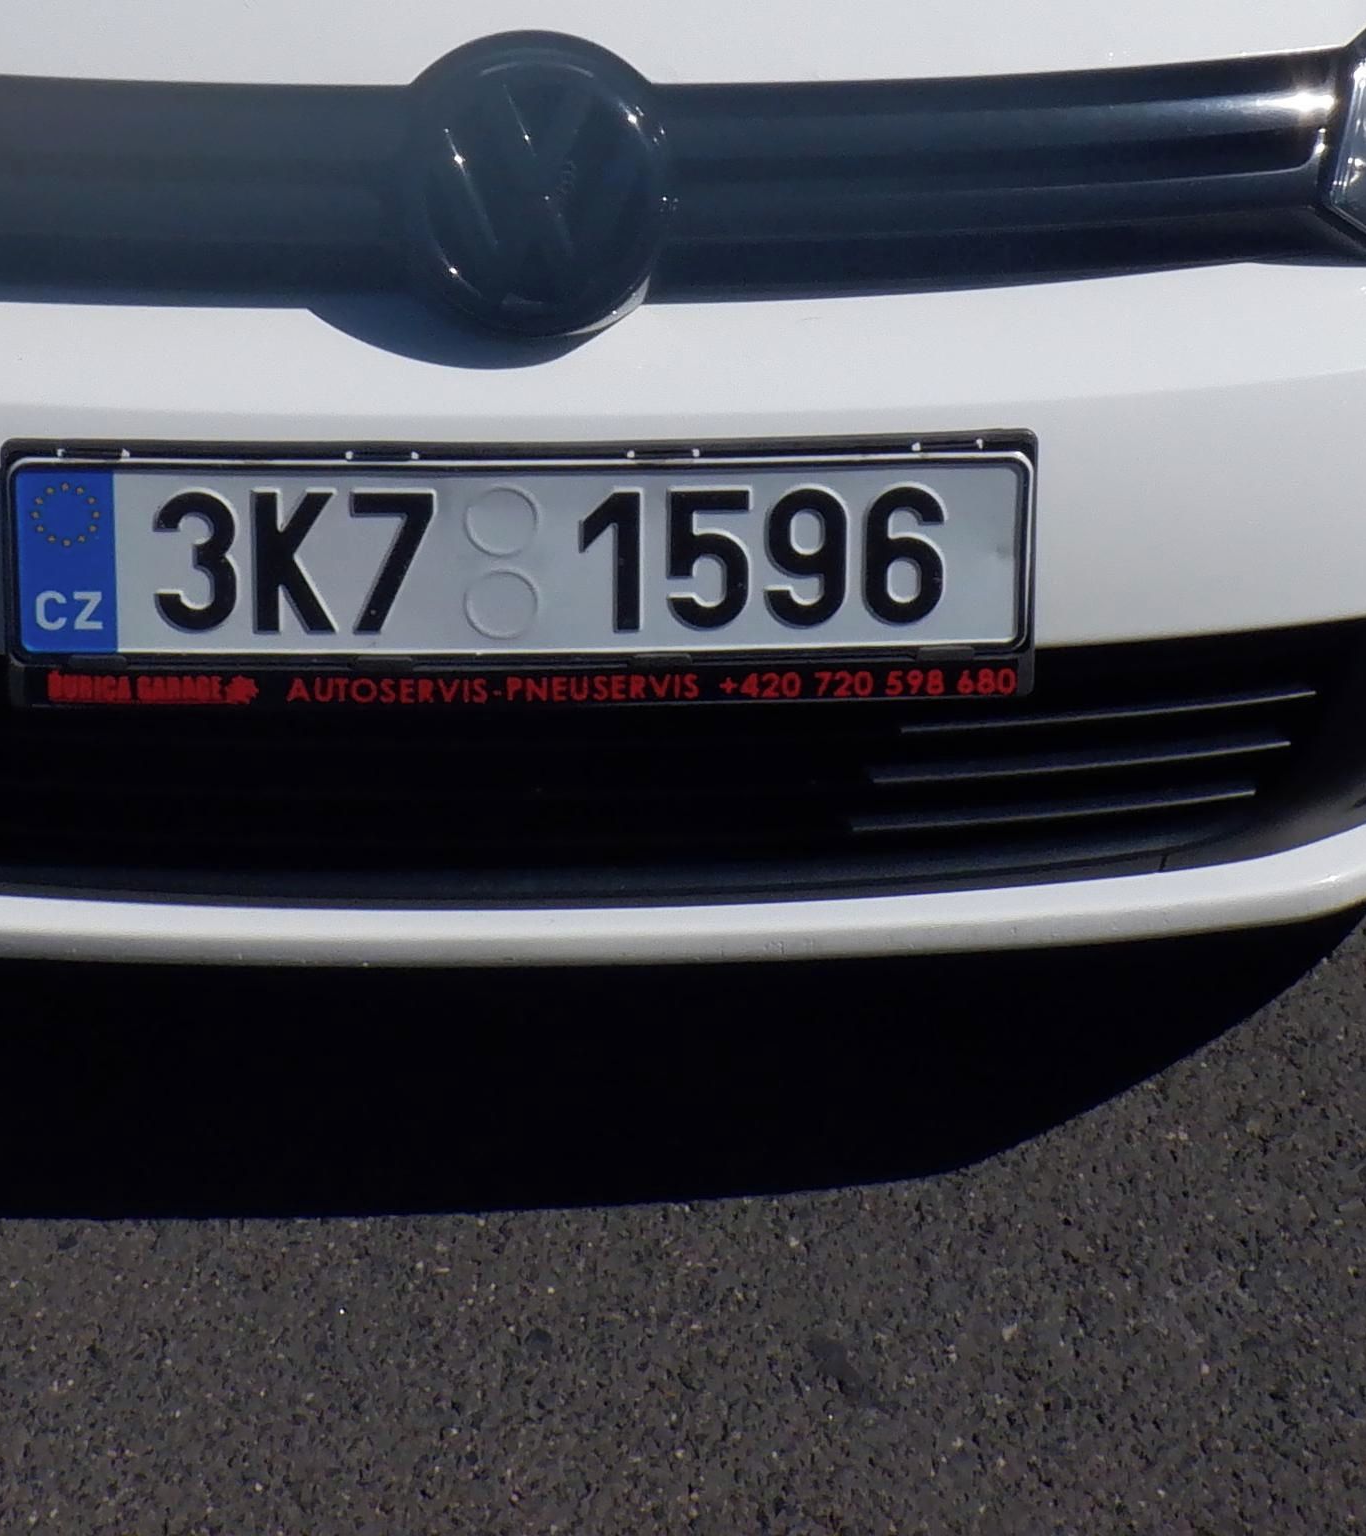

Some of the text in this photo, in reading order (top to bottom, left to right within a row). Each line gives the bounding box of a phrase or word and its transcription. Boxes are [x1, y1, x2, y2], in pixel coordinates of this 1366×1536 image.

[152, 481, 948, 636] 3K7 1596
[34, 590, 104, 631] CZ
[285, 667, 1019, 704] AUTOSERVIS-PNEUSERVIS +420 720 598 680
